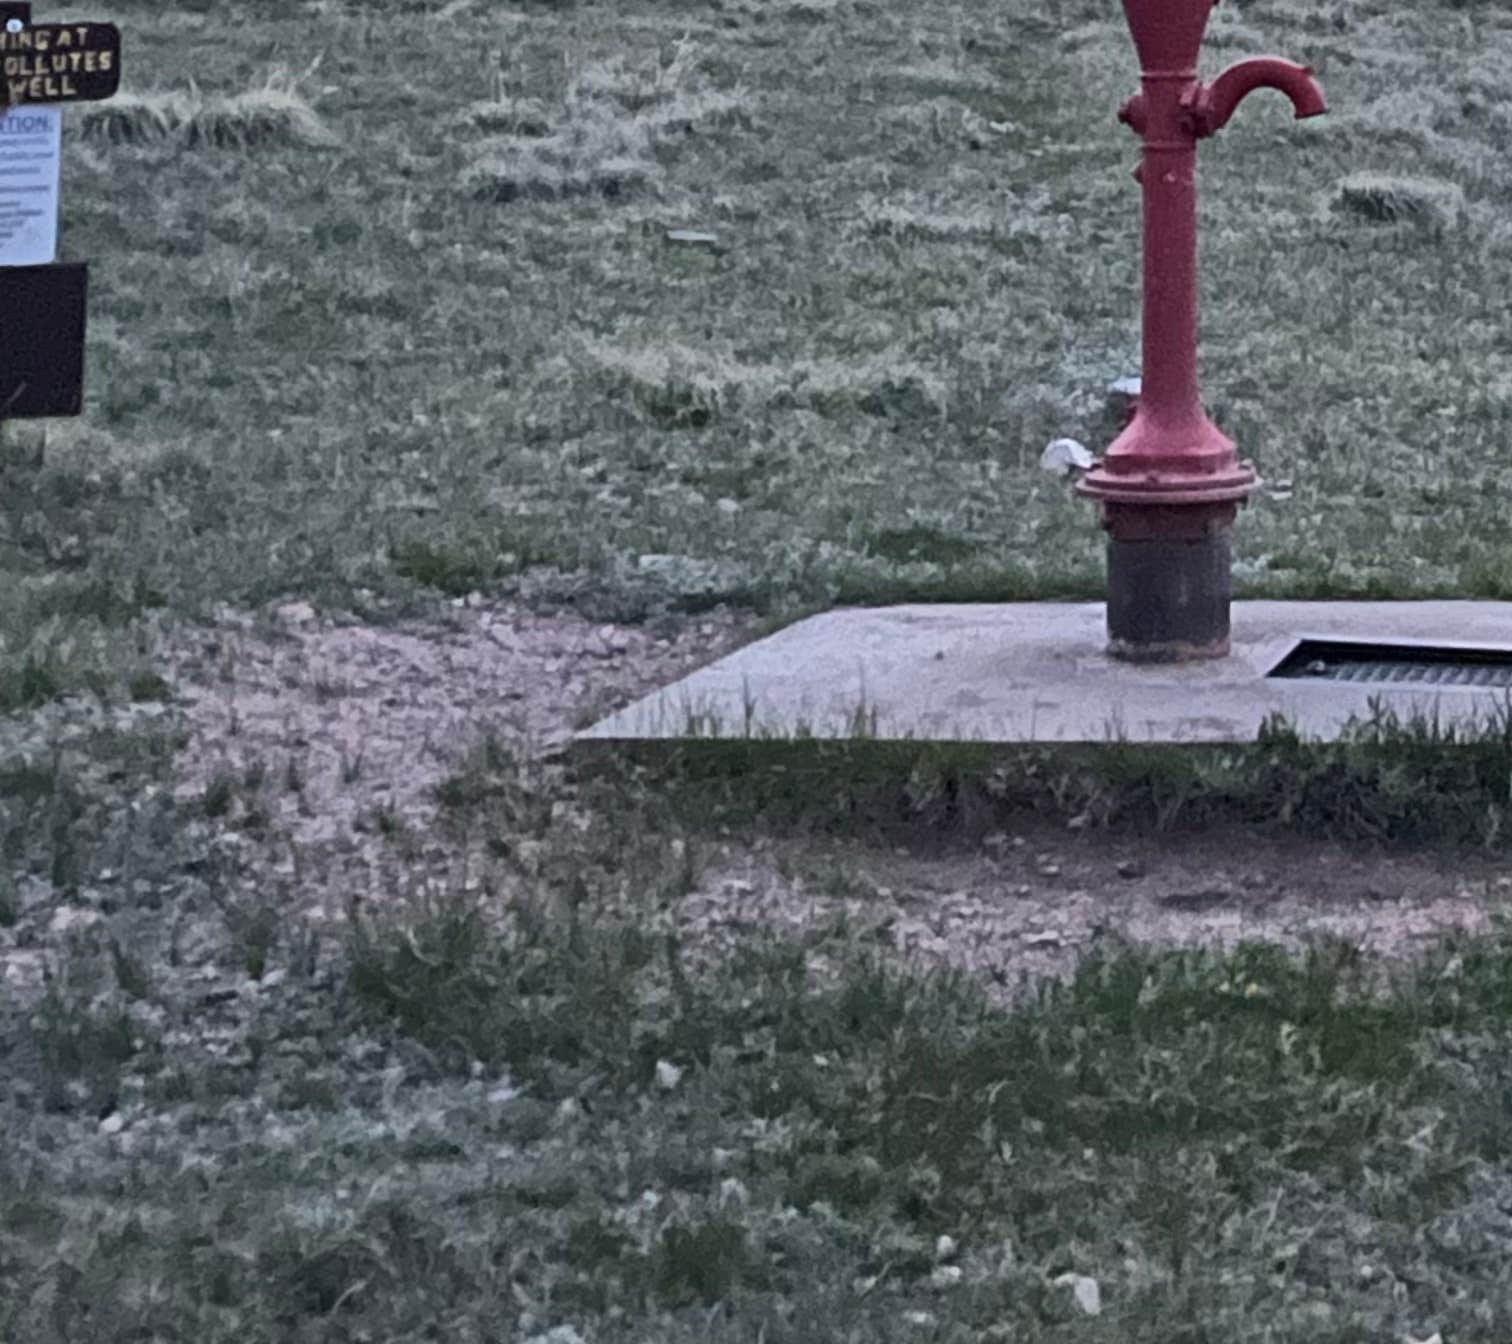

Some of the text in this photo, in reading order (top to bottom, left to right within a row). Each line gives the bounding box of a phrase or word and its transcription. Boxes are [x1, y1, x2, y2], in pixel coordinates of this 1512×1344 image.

[57, 27, 88, 46] AT
[4, 51, 113, 76] OLLUTES
[8, 75, 77, 100] WELL
